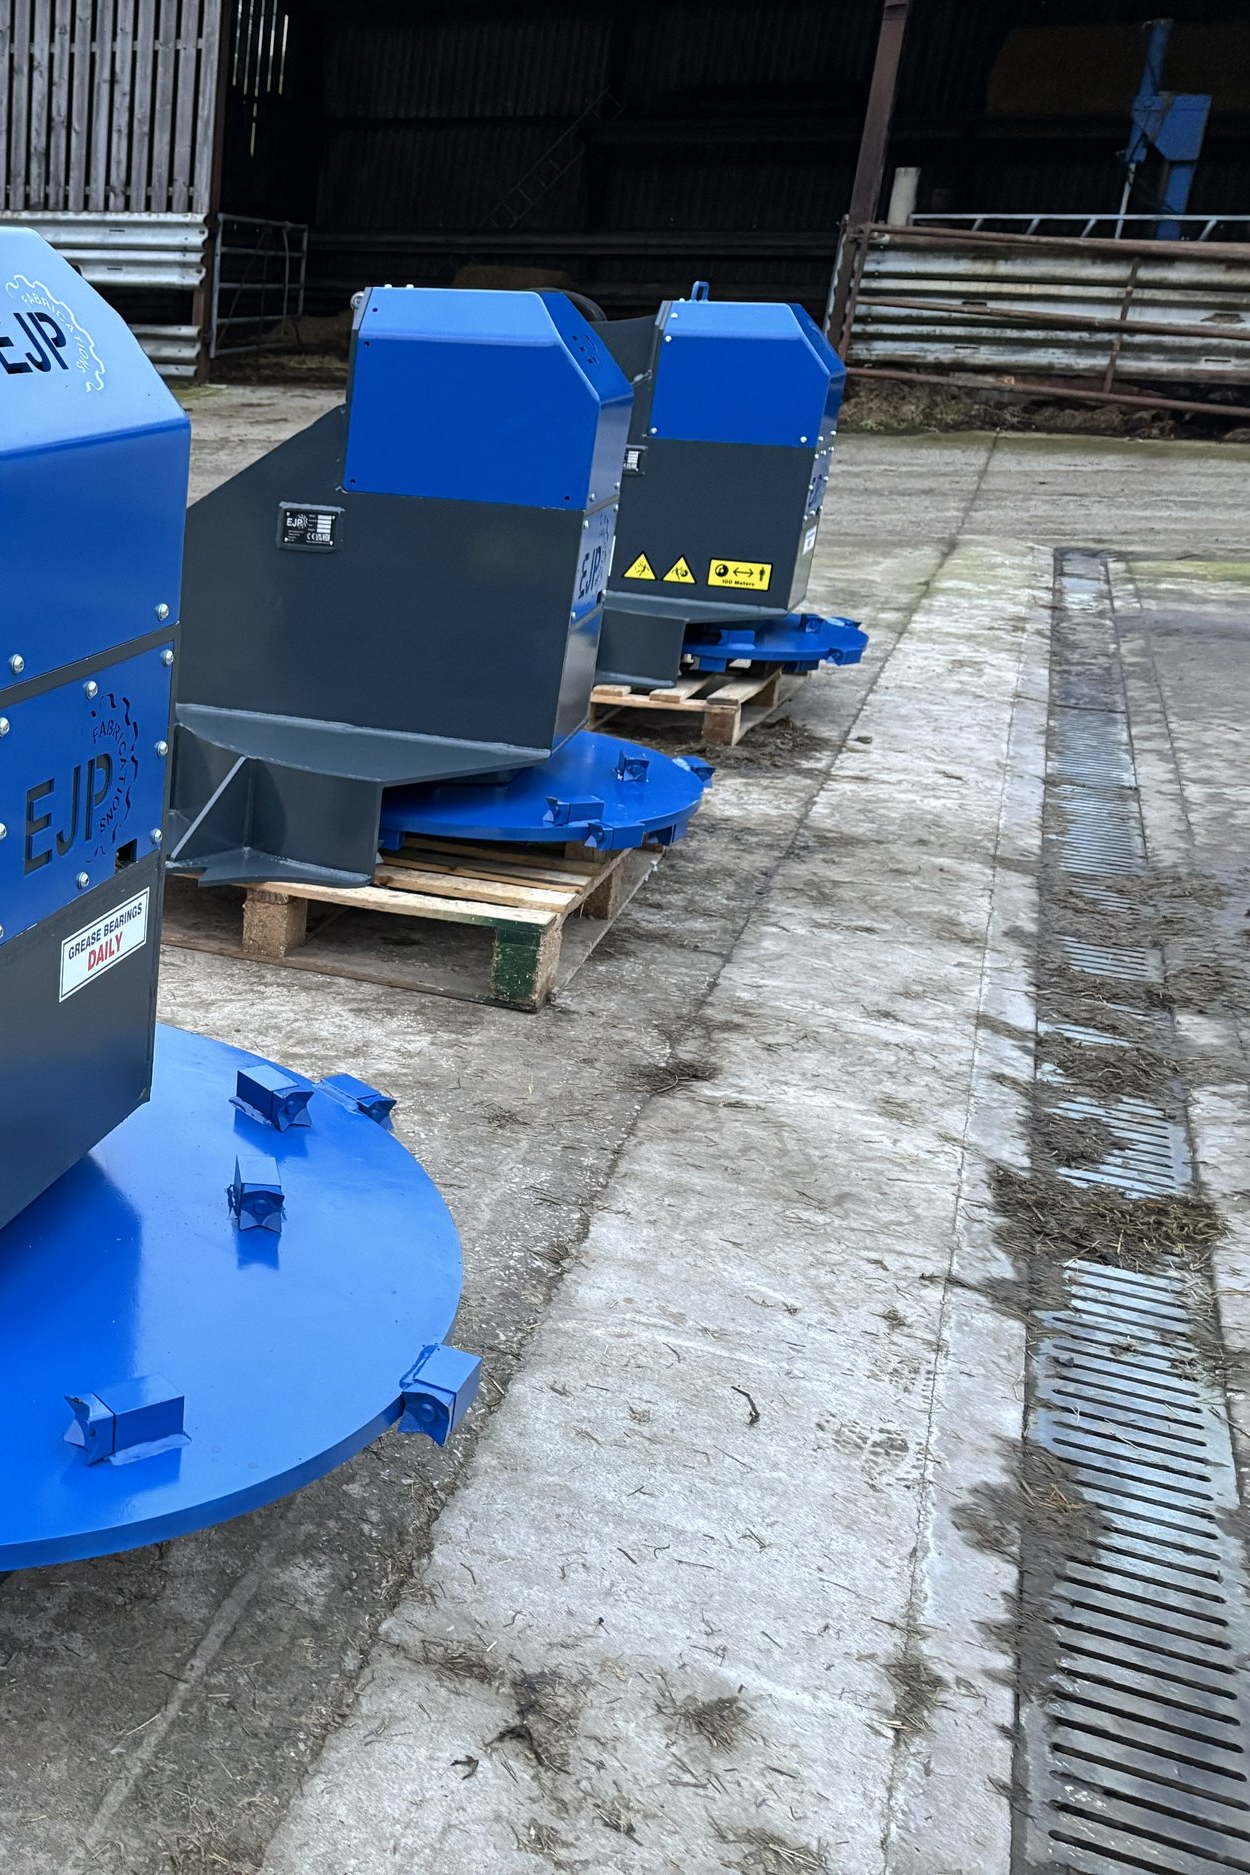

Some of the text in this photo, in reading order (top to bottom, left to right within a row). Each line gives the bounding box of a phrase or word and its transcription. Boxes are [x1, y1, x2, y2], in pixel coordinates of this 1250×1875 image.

[24, 753, 113, 877] EJP
[92, 719, 127, 833] FABRICATIONS
[68, 902, 143, 960] GREASE BEARINGS
[87, 931, 124, 972] DAILY
